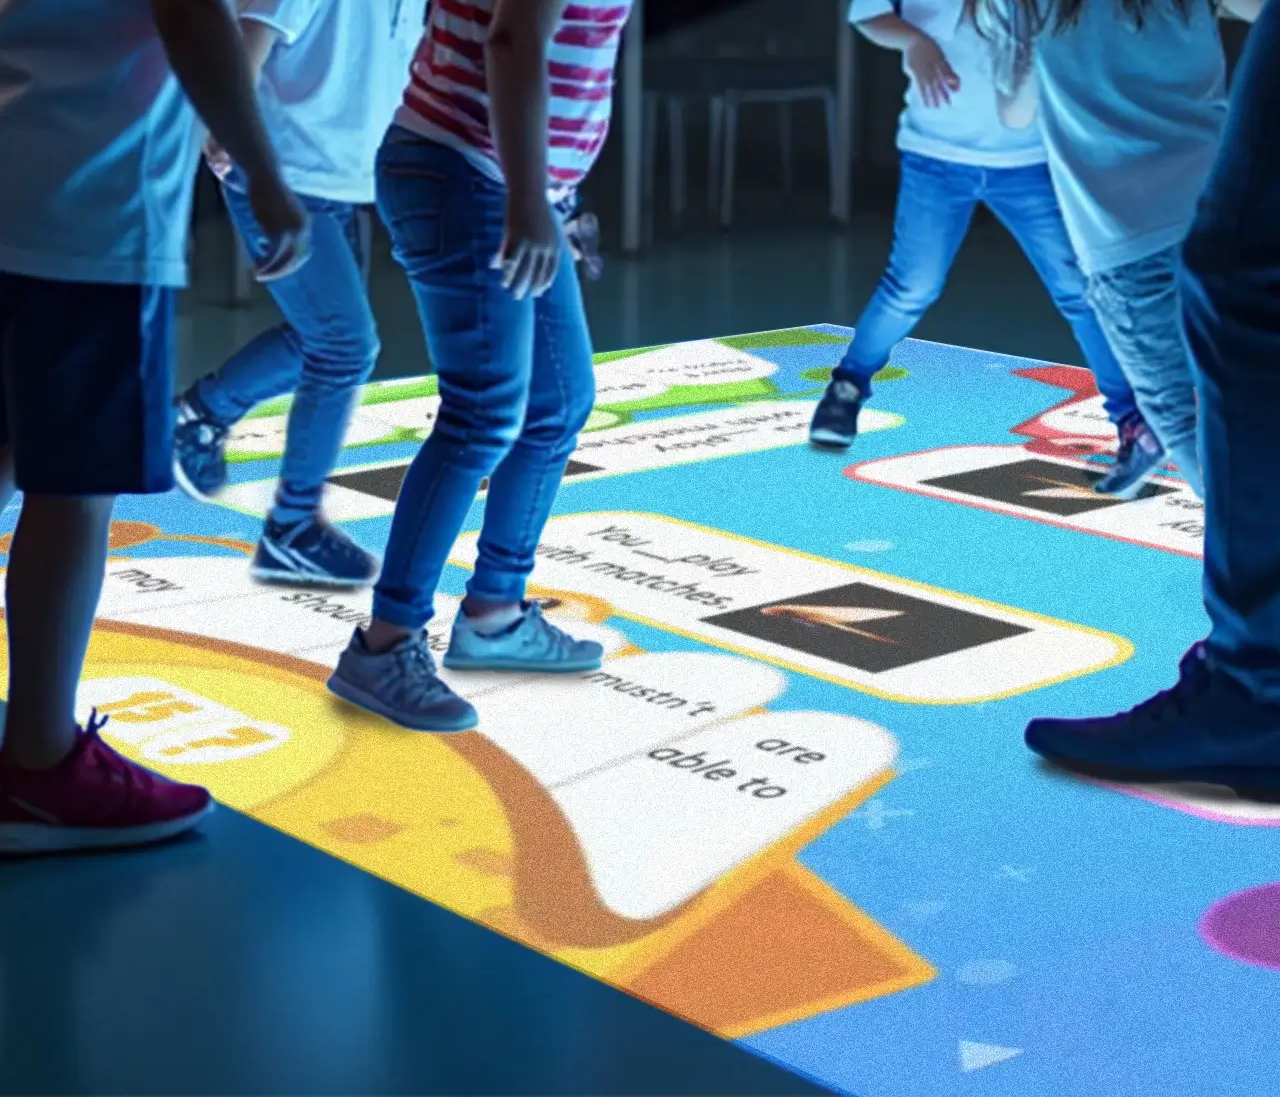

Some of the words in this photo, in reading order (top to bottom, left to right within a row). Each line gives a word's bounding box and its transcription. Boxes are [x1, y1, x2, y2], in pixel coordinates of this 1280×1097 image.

[110, 567, 183, 593] may
[584, 560, 734, 611] matches.
[580, 671, 716, 717] mustn't
[647, 747, 737, 782] able
[737, 776, 788, 800] to
[755, 737, 828, 765] are
